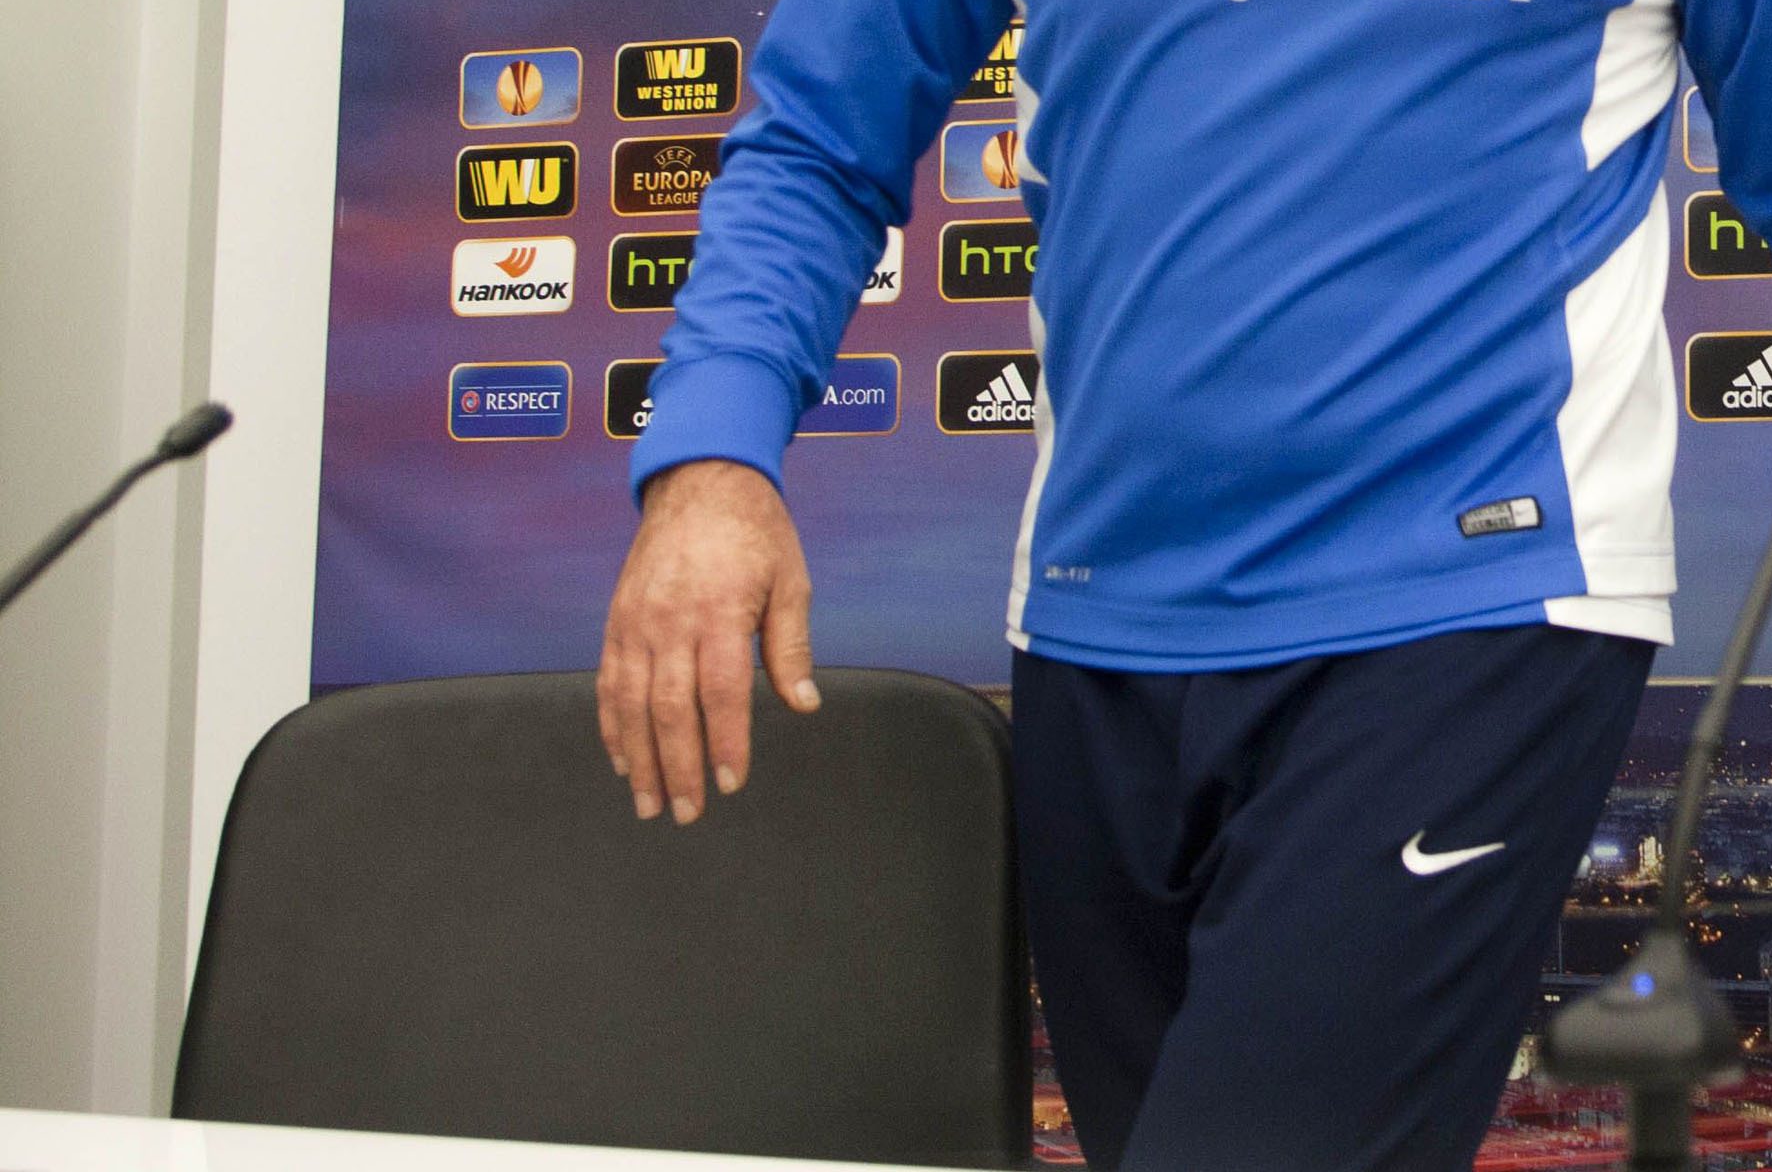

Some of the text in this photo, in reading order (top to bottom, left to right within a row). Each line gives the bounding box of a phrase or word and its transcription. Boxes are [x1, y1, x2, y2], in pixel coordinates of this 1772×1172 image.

[651, 47, 707, 80] WU
[637, 82, 718, 100] WESTERN
[661, 94, 717, 111] UNION
[655, 148, 696, 166] UEFA
[482, 157, 561, 206] WU
[633, 169, 713, 192] EUROPA
[650, 191, 698, 206] LEAGUE
[628, 252, 694, 286] ht
[485, 389, 561, 411] RESPECT
[823, 385, 885, 405] A.com
